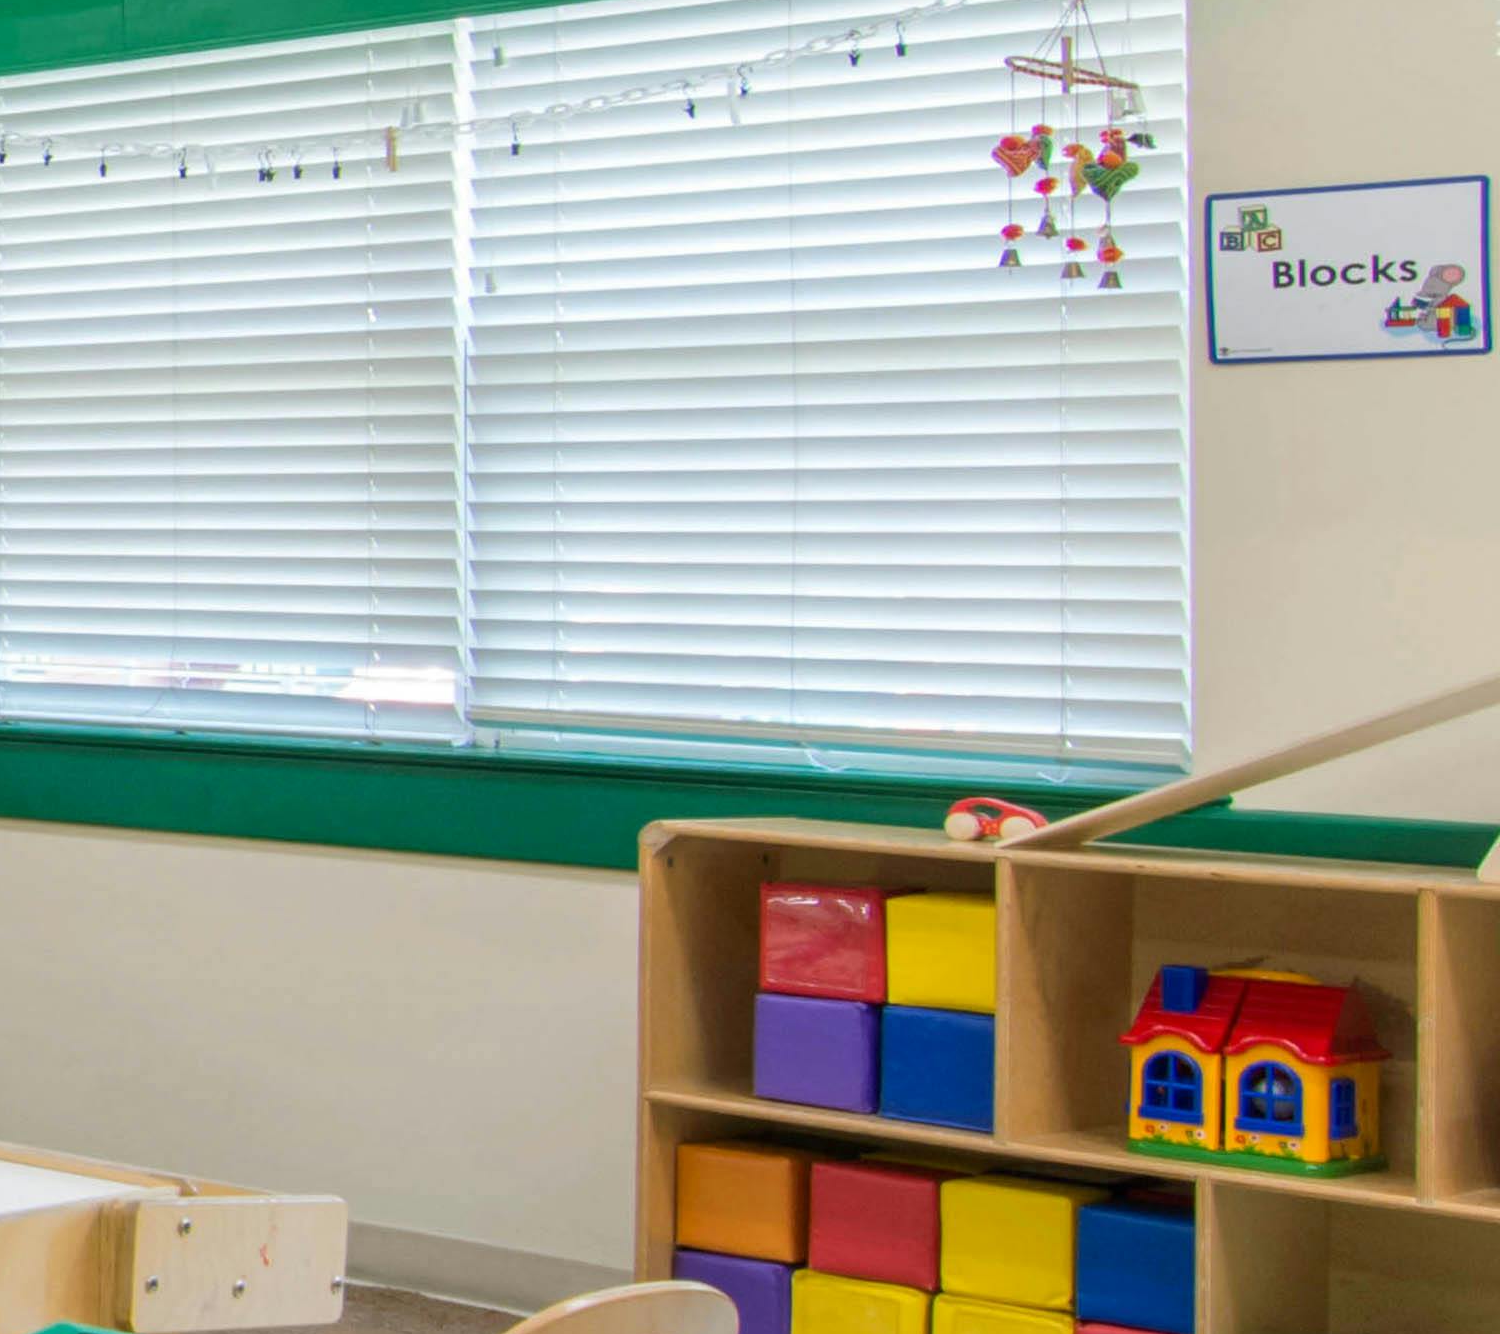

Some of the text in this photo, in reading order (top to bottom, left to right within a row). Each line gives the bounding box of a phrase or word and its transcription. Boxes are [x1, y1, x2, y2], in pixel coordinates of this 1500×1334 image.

[1244, 209, 1266, 230] A
[1225, 233, 1278, 249] B C
[1272, 255, 1418, 289] Blocks
